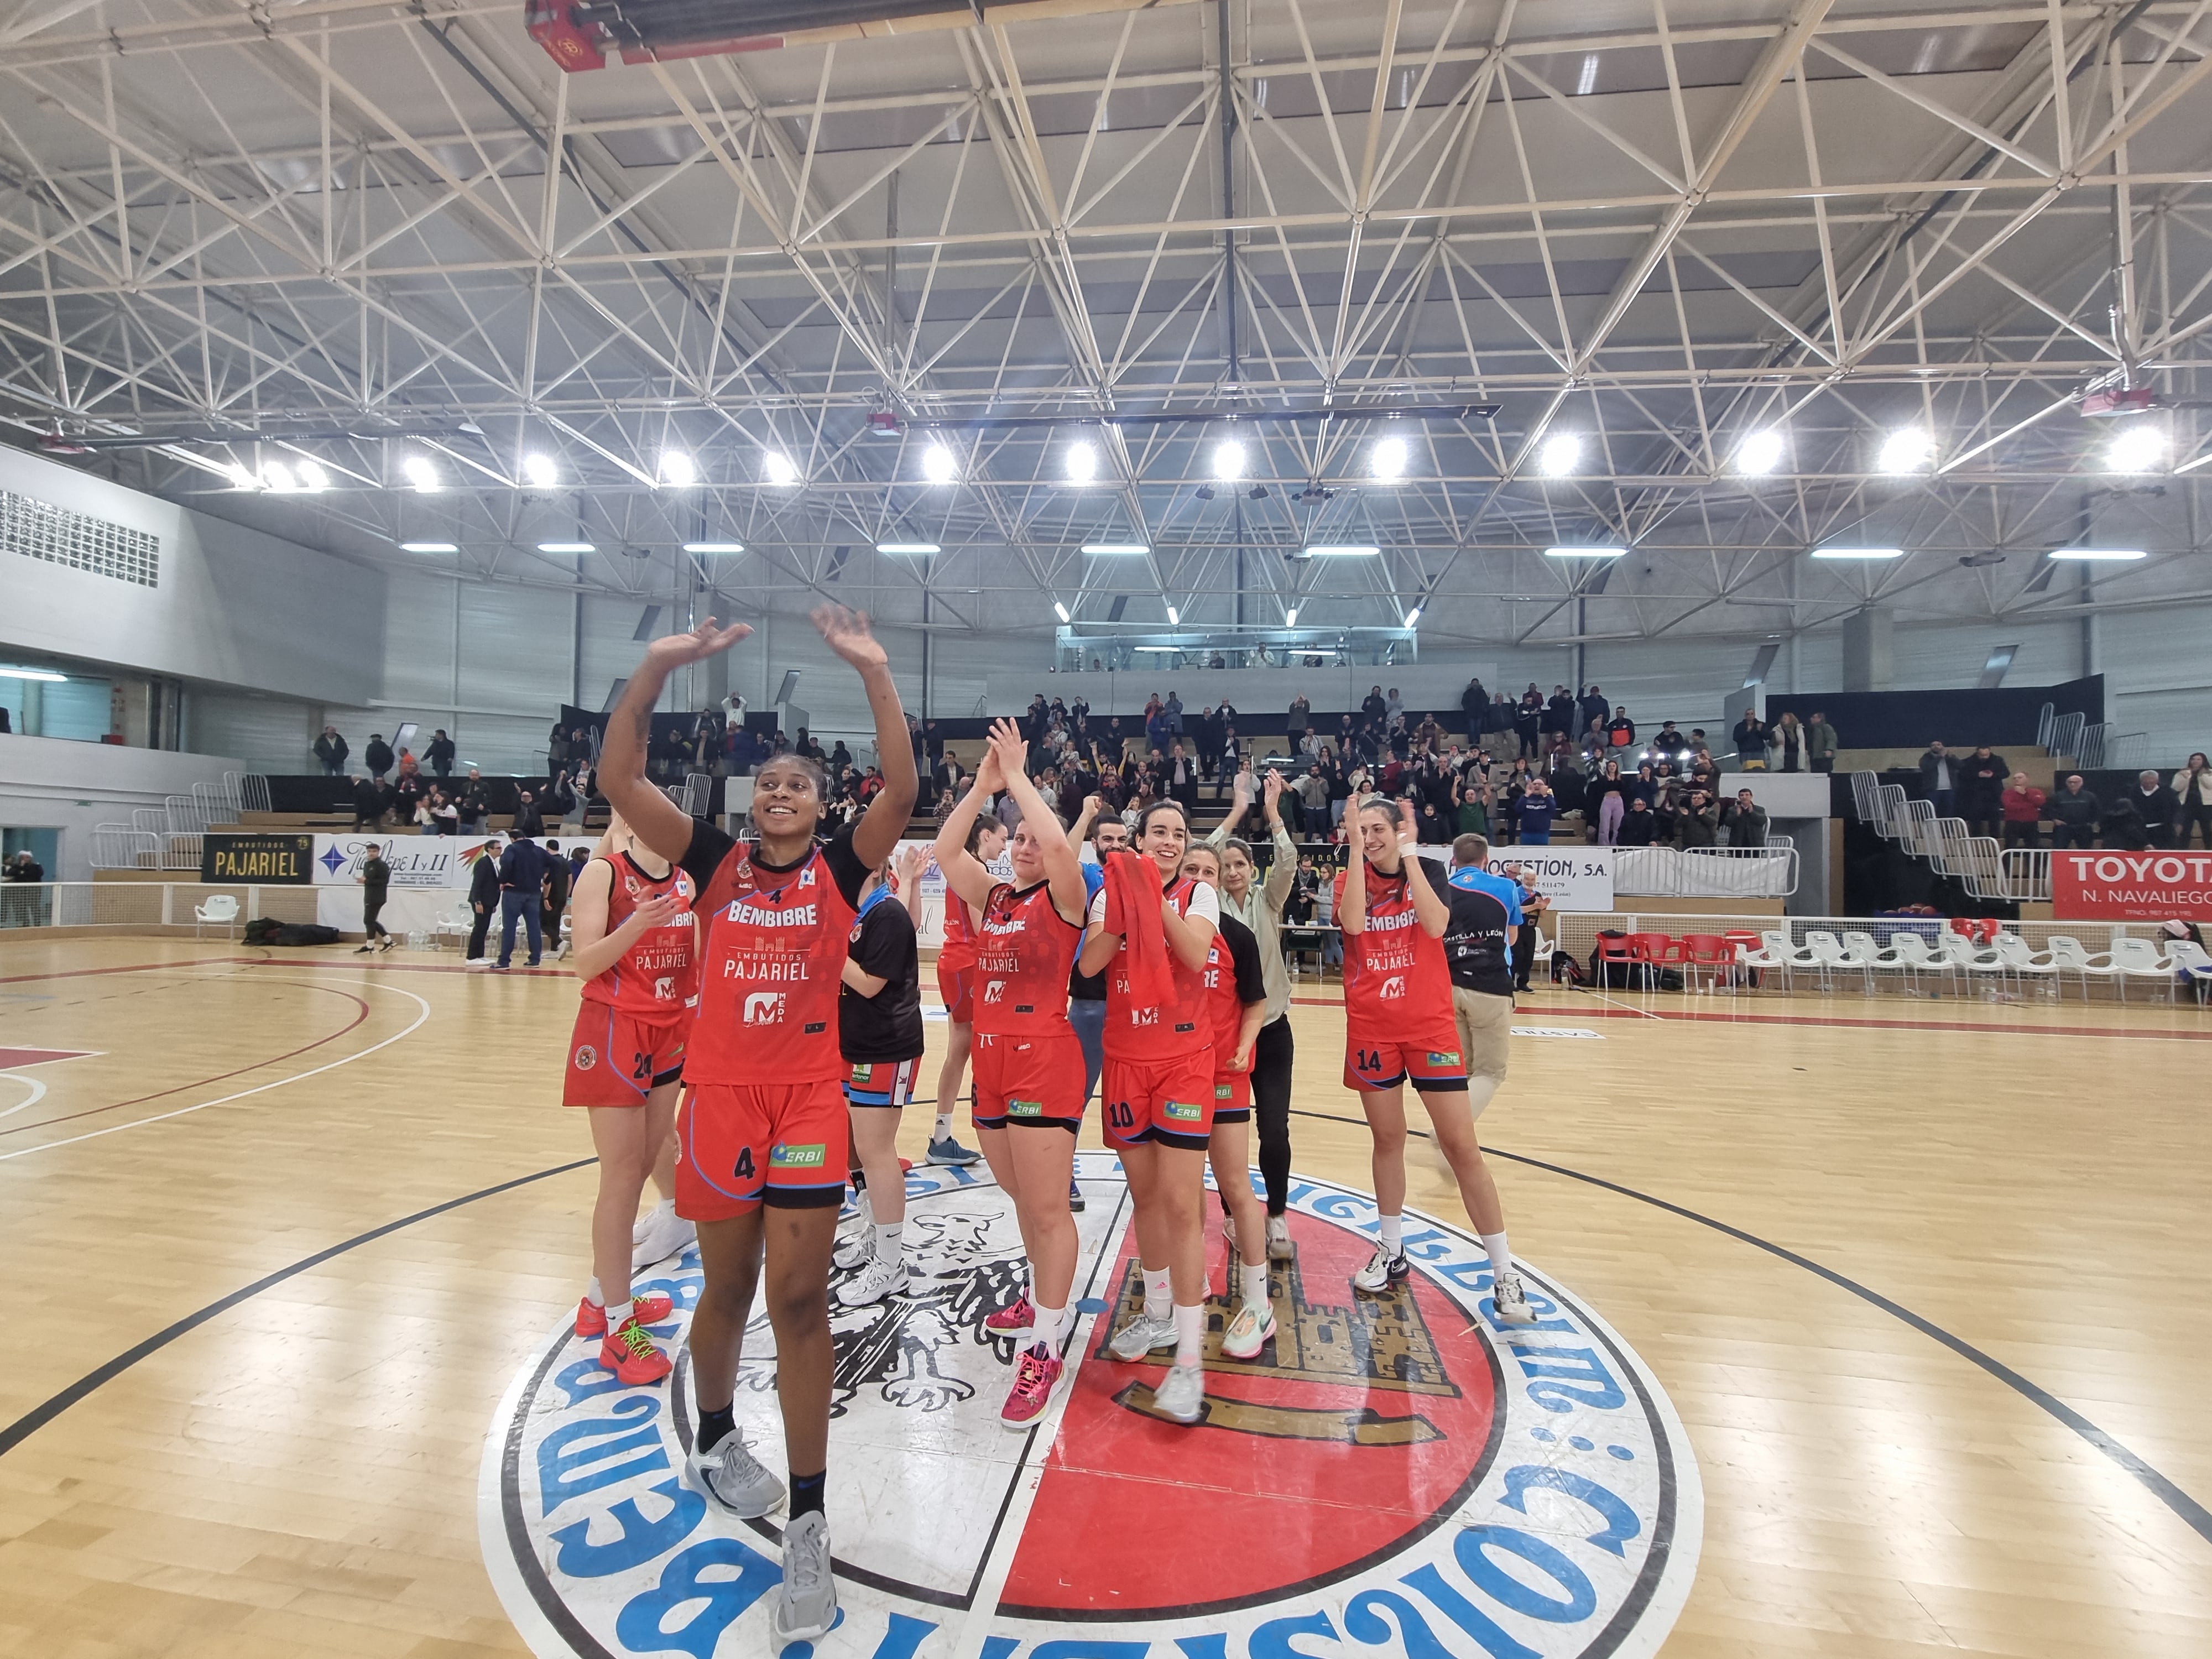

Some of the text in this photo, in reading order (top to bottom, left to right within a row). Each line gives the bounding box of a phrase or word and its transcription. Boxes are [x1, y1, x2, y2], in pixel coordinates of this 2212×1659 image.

[215, 851, 299, 877] PAJARIEL
[1584, 864, 1608, 877] S.A.
[2069, 857, 2212, 883] TOYOT
[768, 889, 782, 904] 4
[2083, 889, 2102, 902] N.
[727, 900, 817, 928] BEMBIBRE
[1478, 930, 1484, 938] Y
[1486, 928, 1504, 938] LEÓN
[636, 953, 687, 970] PAJARIEL
[737, 952, 801, 961] EMBUTIDOS
[723, 959, 810, 982] PAJARIEL
[978, 957, 1020, 972] PAJARIEL
[777, 992, 786, 1023] MEDA
[1357, 1049, 1382, 1071] 14
[1215, 1088, 1230, 1097] RBI
[1016, 1106, 1039, 1115] ERBI
[1109, 1102, 1135, 1128] 10
[1176, 1108, 1201, 1118] ERBI
[734, 1146, 756, 1180] 4
[785, 1150, 822, 1163] ERBI
